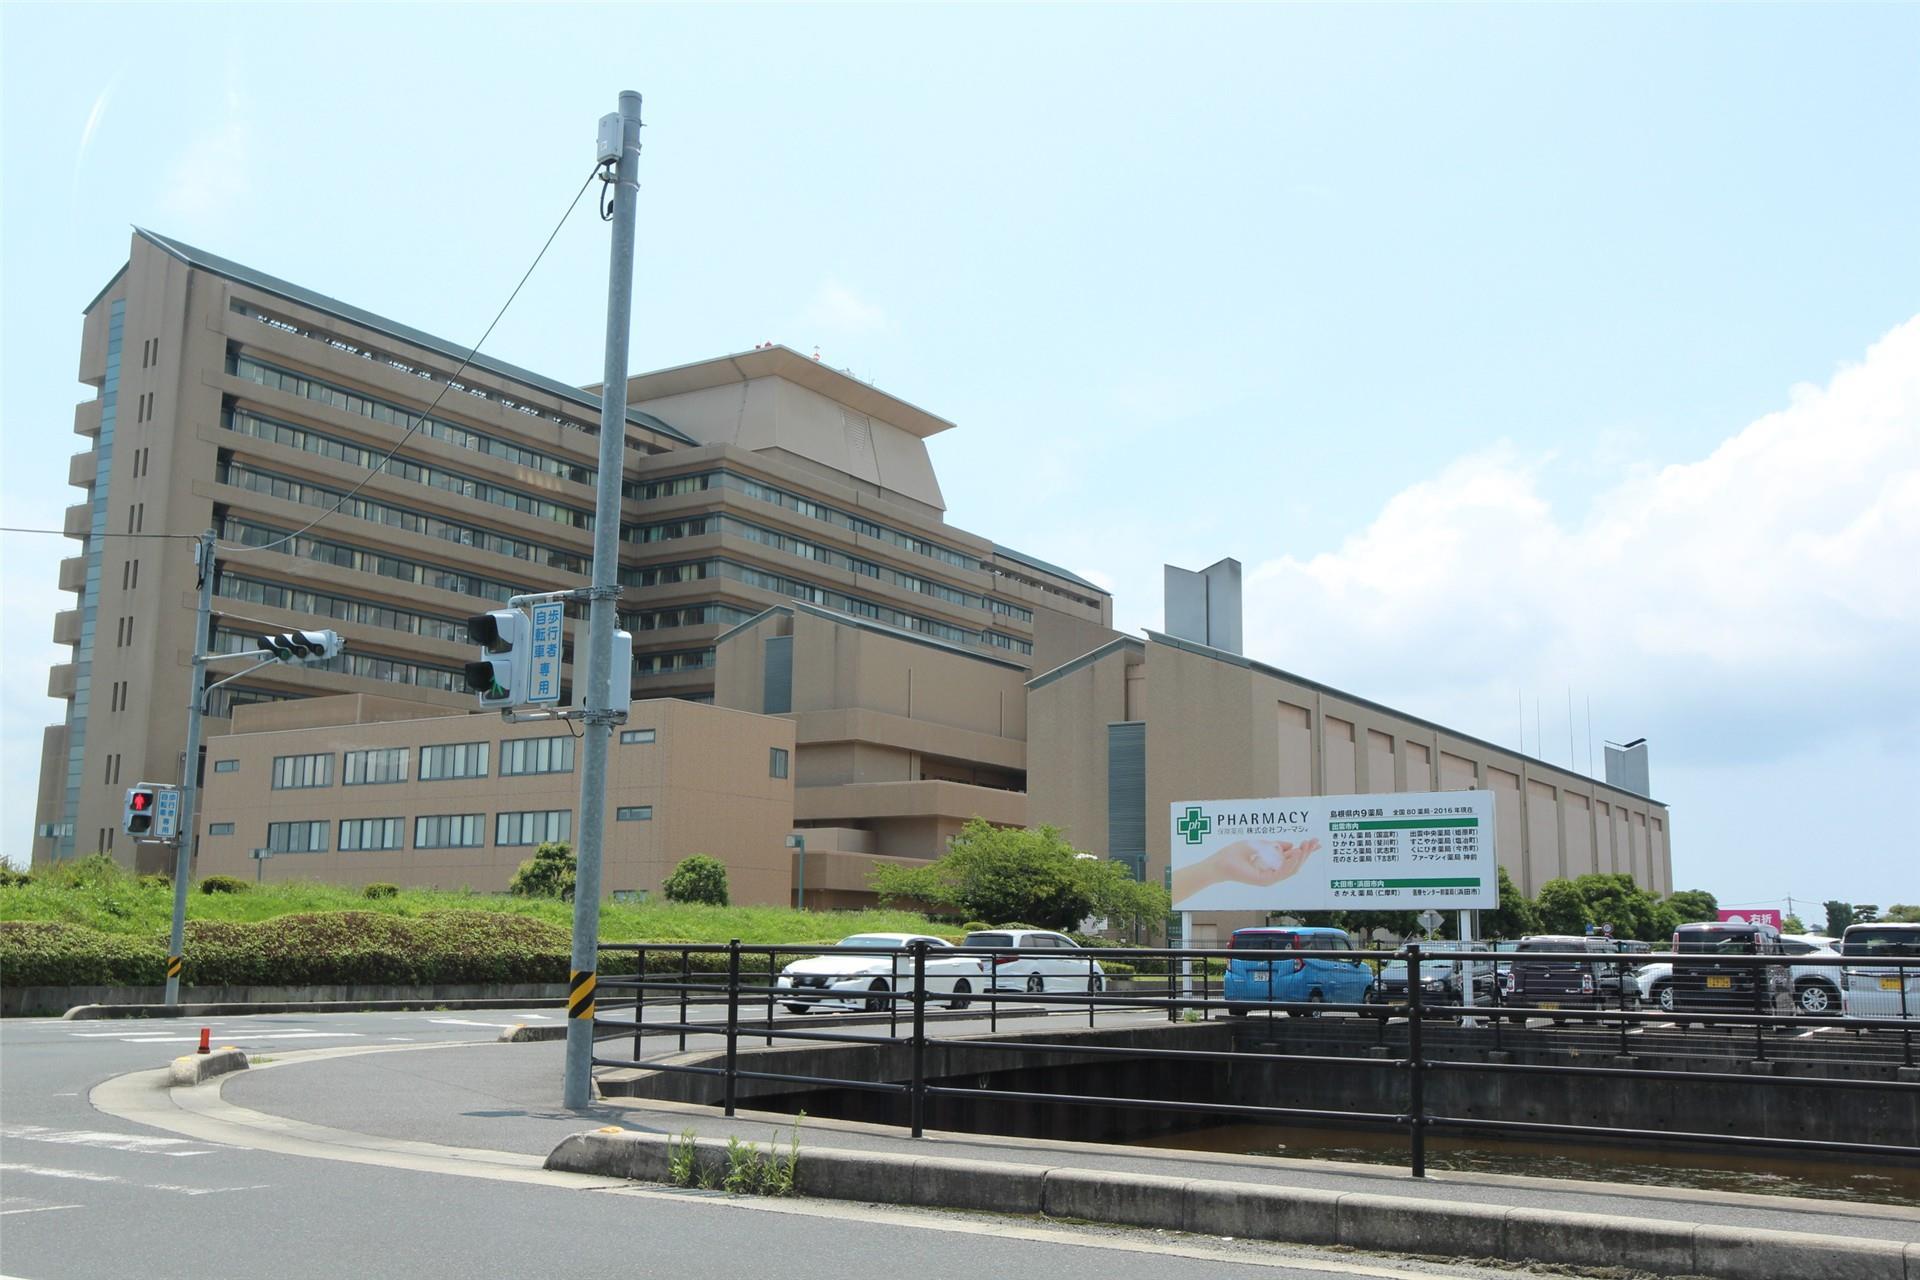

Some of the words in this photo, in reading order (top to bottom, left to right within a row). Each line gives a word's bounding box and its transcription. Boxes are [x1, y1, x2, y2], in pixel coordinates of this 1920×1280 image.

[534, 611, 546, 658] 自転車
[546, 609, 559, 658] 歩行者
[538, 662, 551, 695] 専用
[1217, 810, 1309, 826] PHARMACY
